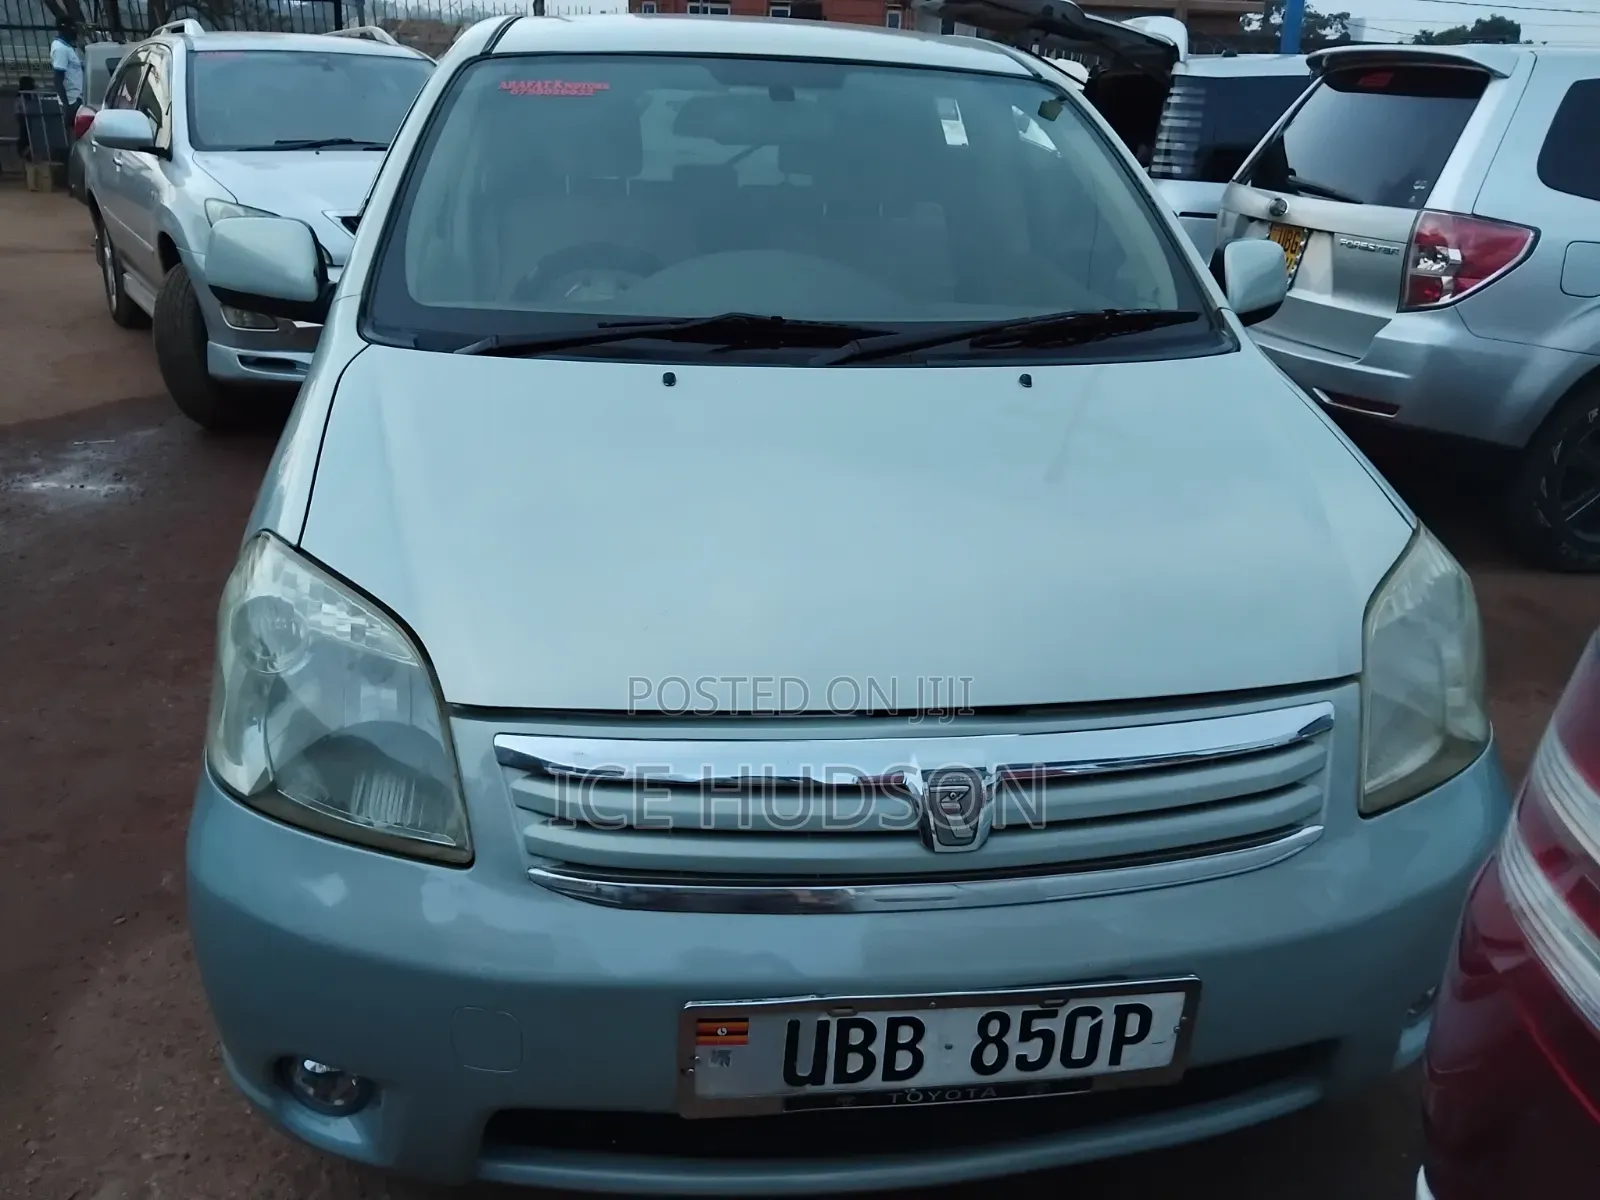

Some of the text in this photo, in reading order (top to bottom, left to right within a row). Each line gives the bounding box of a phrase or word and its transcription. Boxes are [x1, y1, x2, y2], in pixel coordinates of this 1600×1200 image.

[1339, 238, 1400, 256] FORESTER
[782, 1003, 1153, 1087] UBB 850P
[889, 1087, 998, 1104] TOYOTA
